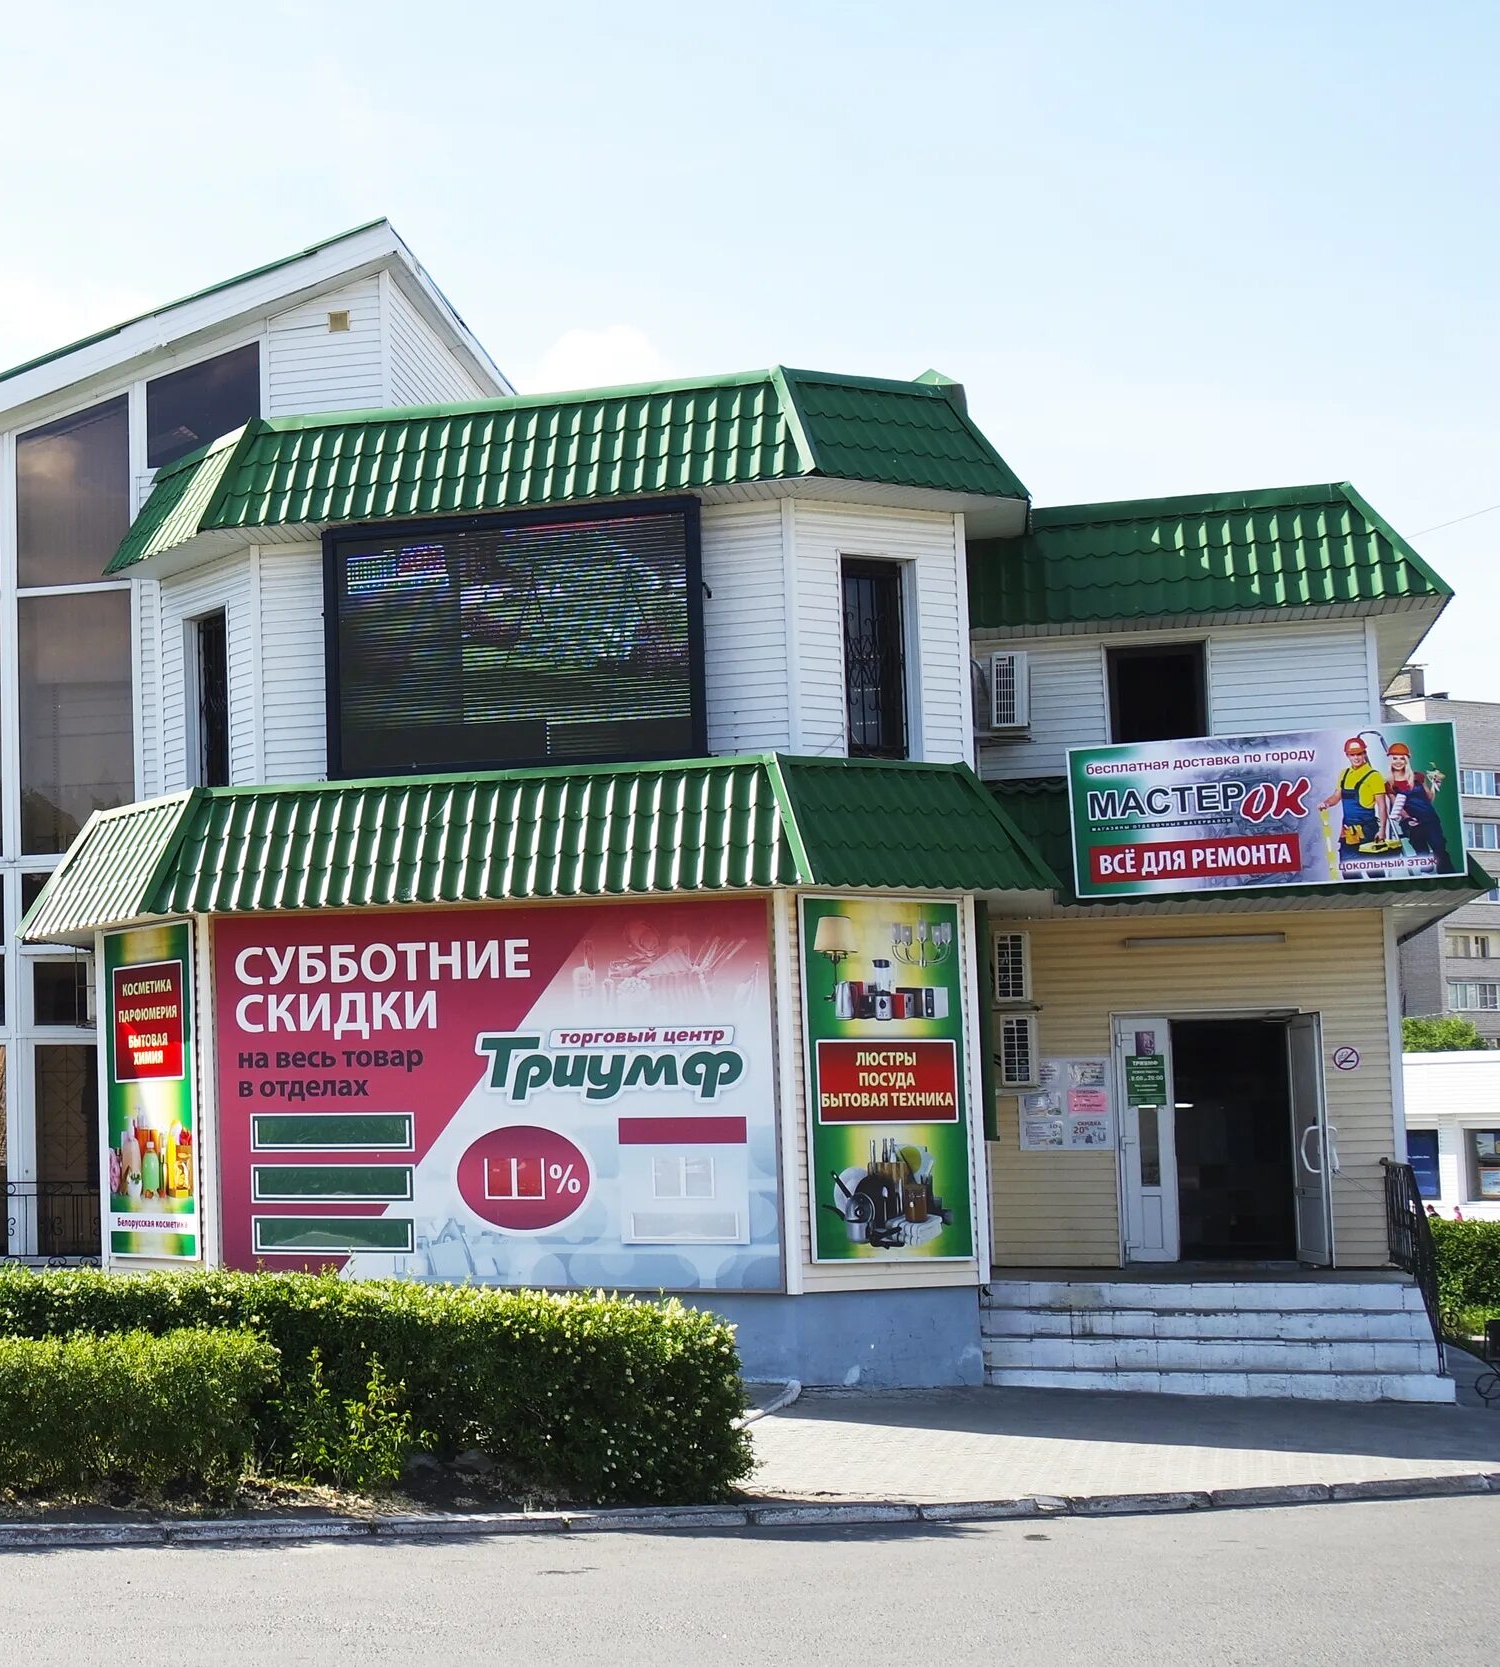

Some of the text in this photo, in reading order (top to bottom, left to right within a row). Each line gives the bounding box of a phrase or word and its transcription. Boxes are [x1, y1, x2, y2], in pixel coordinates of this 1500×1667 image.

[1086, 749, 1315, 775] бесплатная доставка по городу
[1100, 842, 1292, 876] ВСЁ ДЛЯ РЕМОНТА
[1338, 856, 1438, 873] цокольный этаж
[234, 938, 531, 986] СУББОТНИЕ
[122, 978, 173, 997] КОСМЕТИКА
[118, 1004, 178, 1023] ПАРФЮМЕРИЯ
[235, 990, 438, 1041] СКИДКИ
[128, 1032, 168, 1049] БЫТОВАЯ
[559, 1026, 725, 1048] торговый центр
[133, 1050, 164, 1066] ХИМИЯ
[238, 1049, 424, 1072] на весь товар
[855, 1051, 917, 1067] ЛЮСТРЫ
[481, 1036, 744, 1101] Триумф
[238, 1078, 369, 1102] в отделах
[858, 1072, 916, 1090] ПОСУДА
[821, 1092, 954, 1108] БЫТОВАЯ ТЕХНИКА
[549, 1163, 581, 1194] %
[117, 1217, 155, 1229] Белорусская
